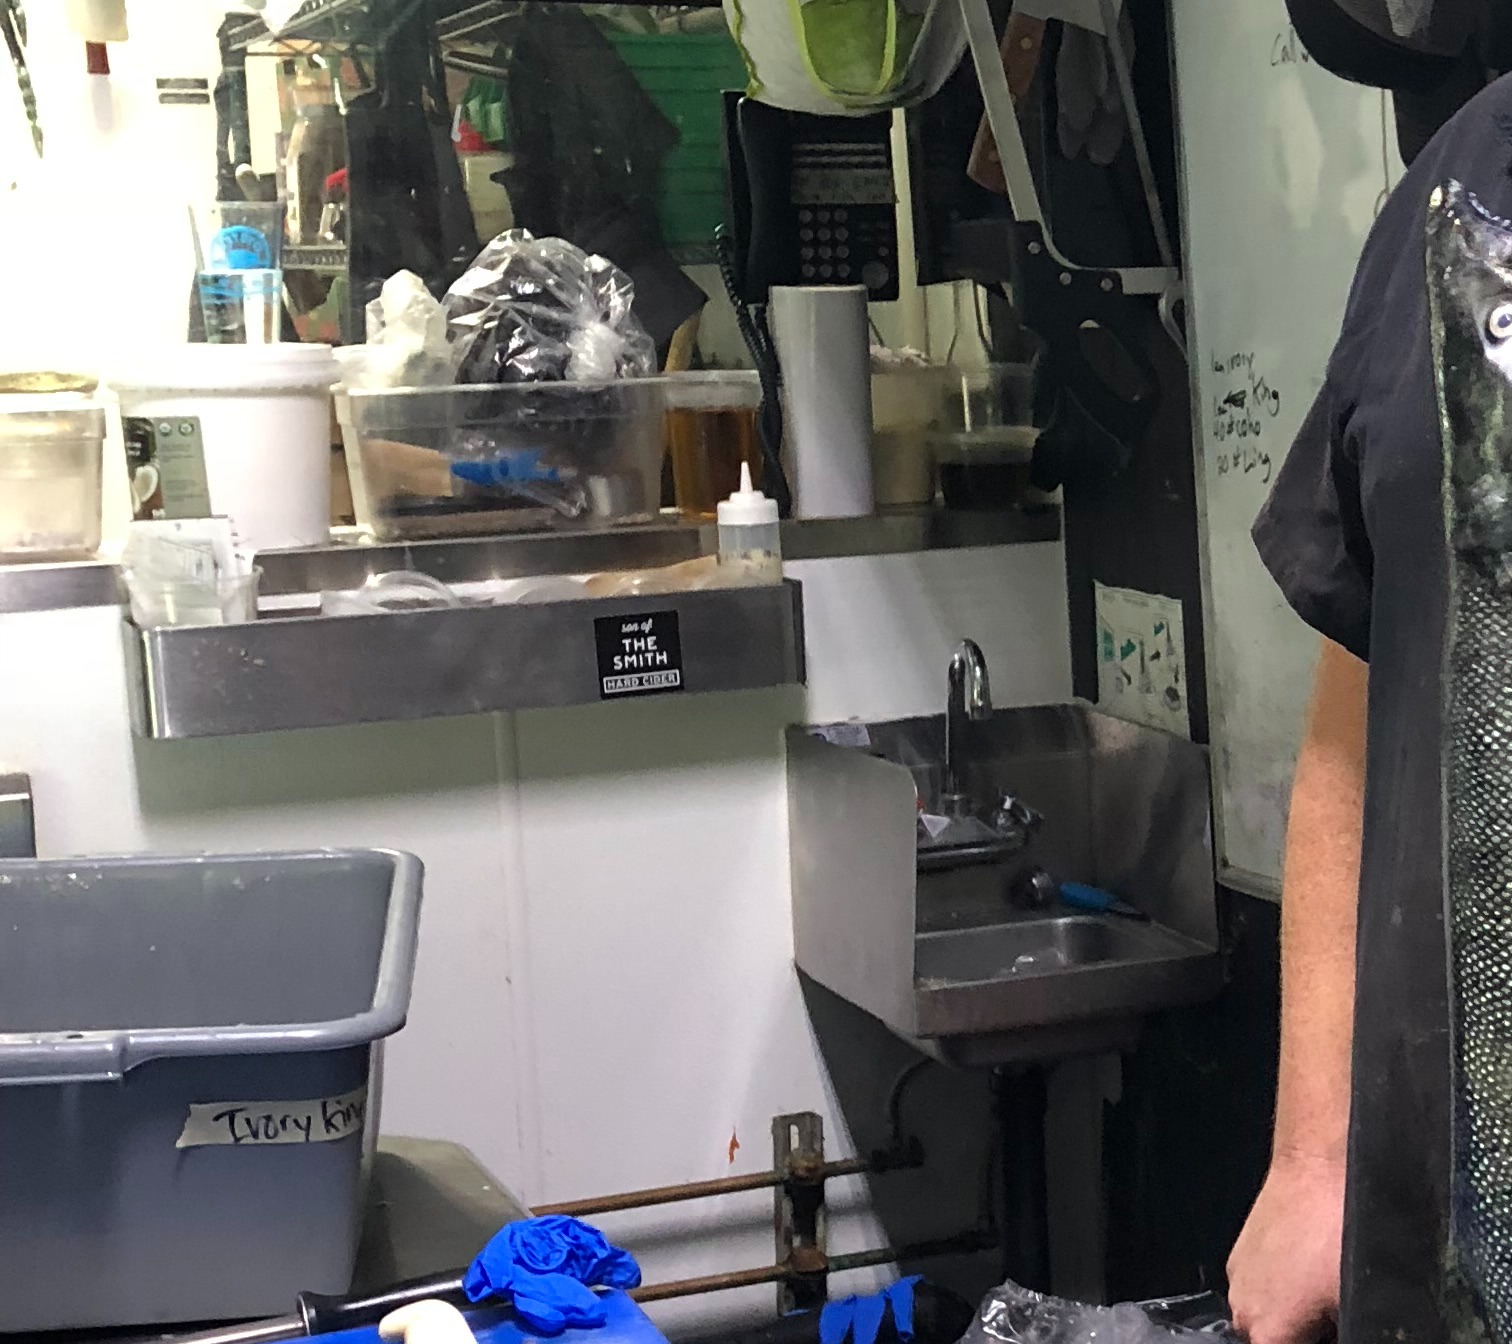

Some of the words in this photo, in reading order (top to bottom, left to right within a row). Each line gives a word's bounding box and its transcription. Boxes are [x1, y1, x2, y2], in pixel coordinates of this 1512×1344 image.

[622, 635, 657, 653] THE
[613, 650, 668, 670] SMITH
[607, 677, 640, 690] HARD
[642, 673, 676, 687] CIDER
[212, 1107, 312, 1144] Ivory
